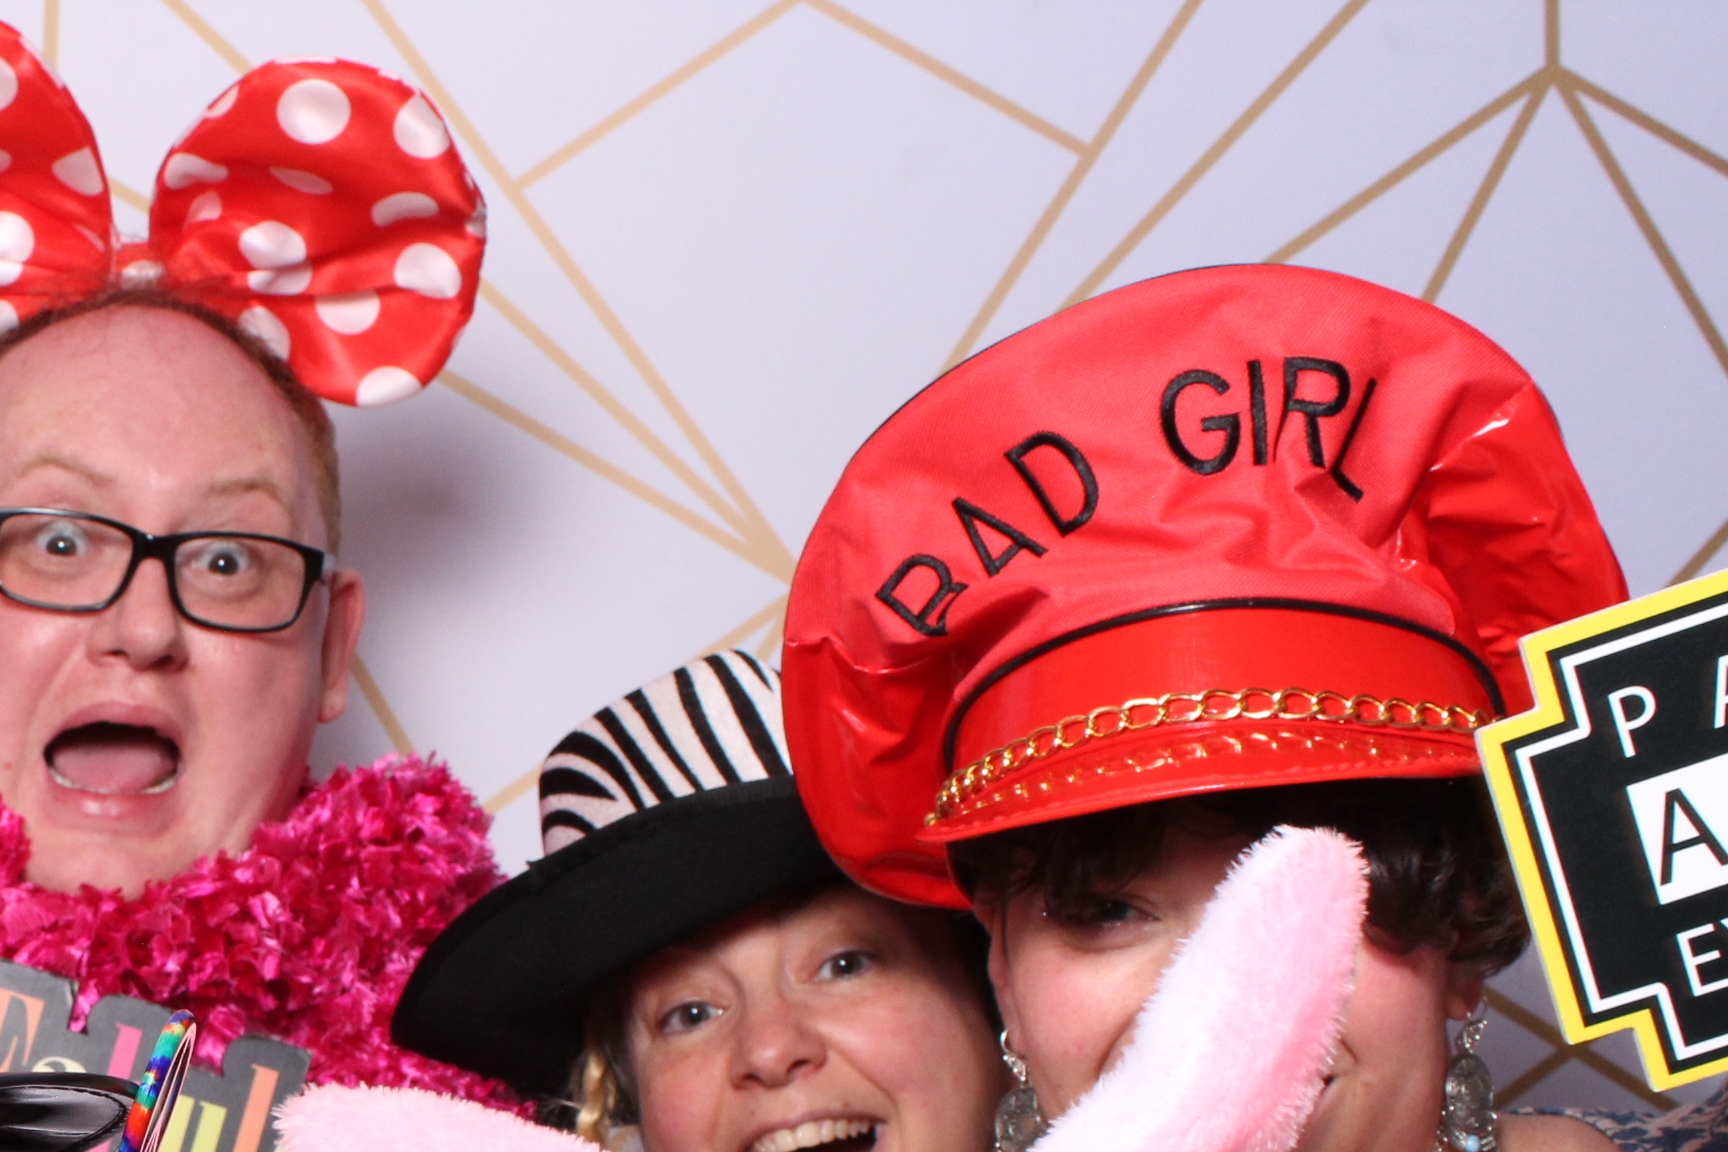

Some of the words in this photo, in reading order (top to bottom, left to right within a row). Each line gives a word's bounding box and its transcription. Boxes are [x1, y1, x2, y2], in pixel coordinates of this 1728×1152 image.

[876, 430, 1100, 637] BAD
[1159, 356, 1378, 503] GIRL
[1606, 685, 1728, 759] P
[1676, 918, 1728, 997] E
